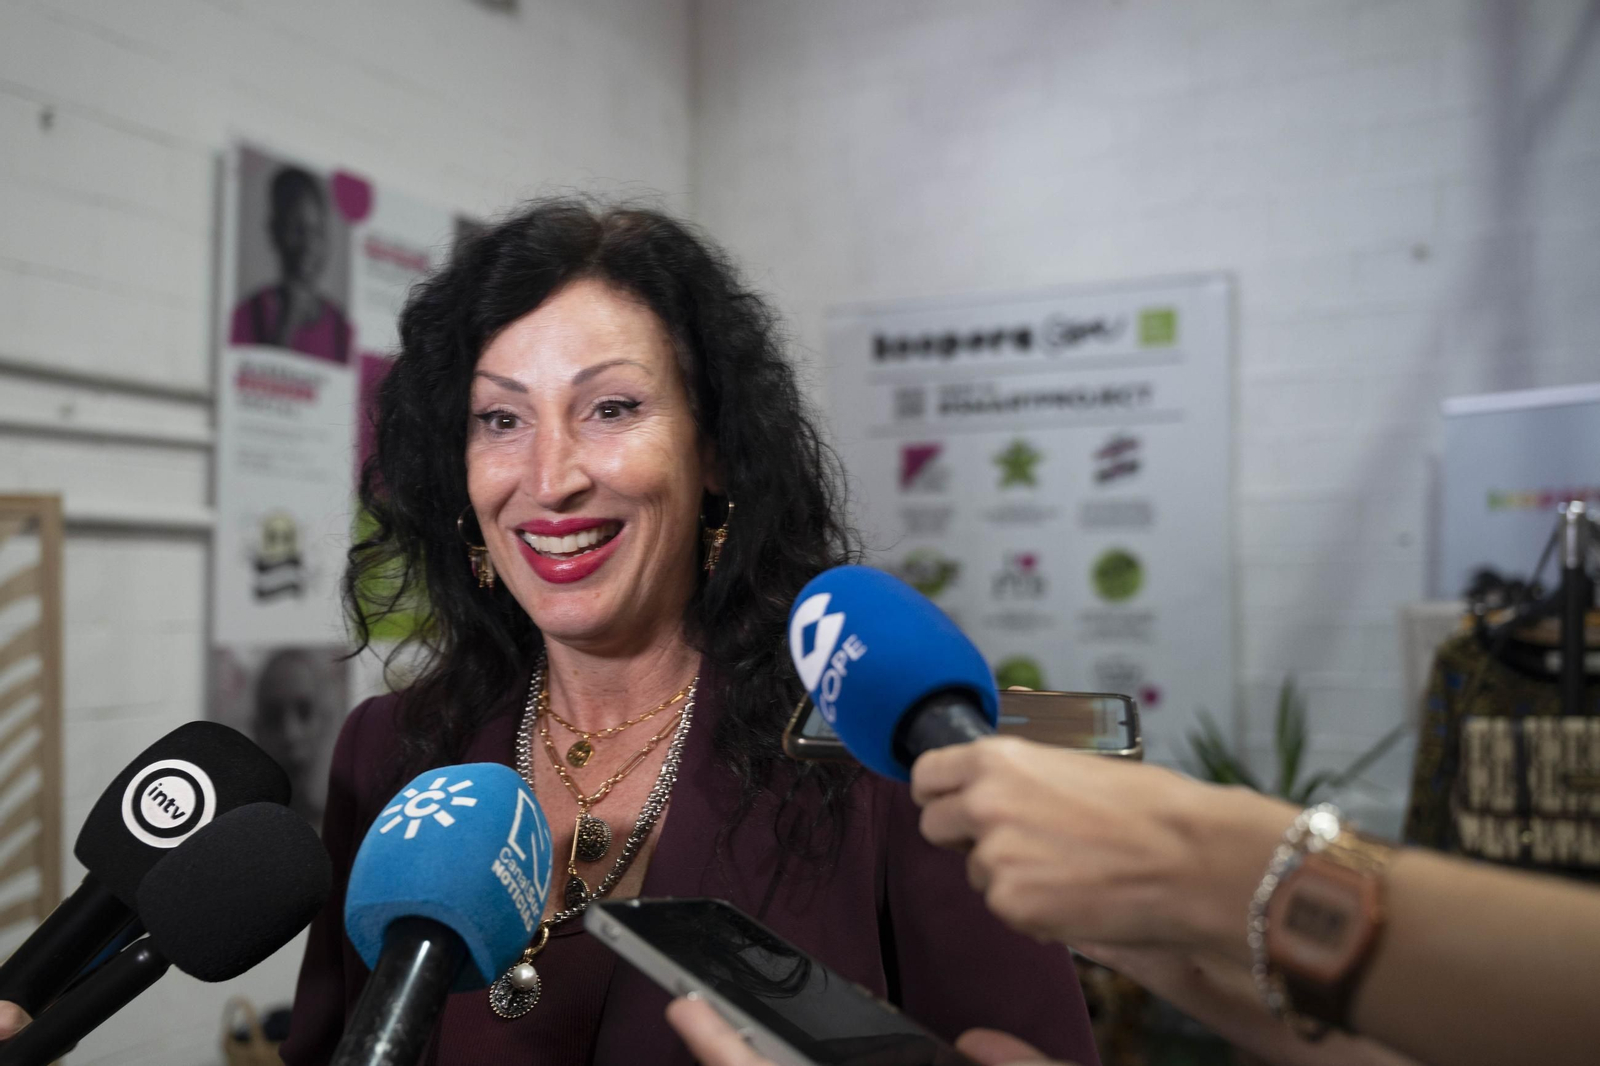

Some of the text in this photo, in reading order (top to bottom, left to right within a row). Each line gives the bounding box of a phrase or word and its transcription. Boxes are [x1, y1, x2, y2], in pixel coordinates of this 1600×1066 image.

[820, 634, 868, 723] COPE
[148, 783, 185, 820] intv
[491, 859, 534, 932] NOTICIAS
